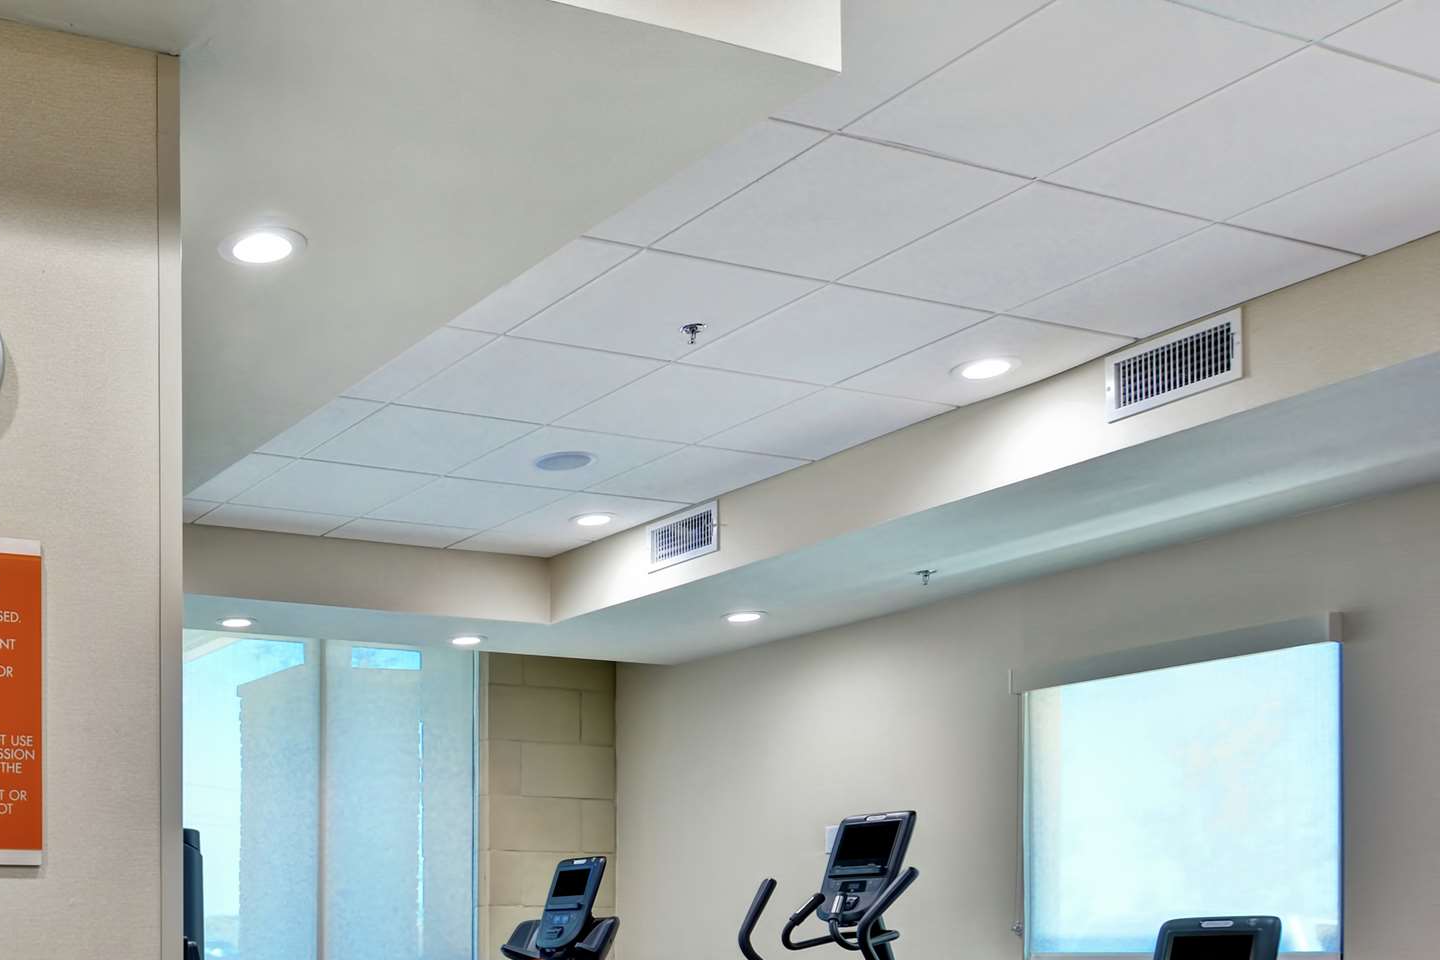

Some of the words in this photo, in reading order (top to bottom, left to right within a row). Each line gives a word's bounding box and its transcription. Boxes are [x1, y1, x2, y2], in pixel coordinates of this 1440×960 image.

[11, 735, 33, 746] USE
[1, 763, 22, 773] THE
[9, 790, 27, 801] OR
